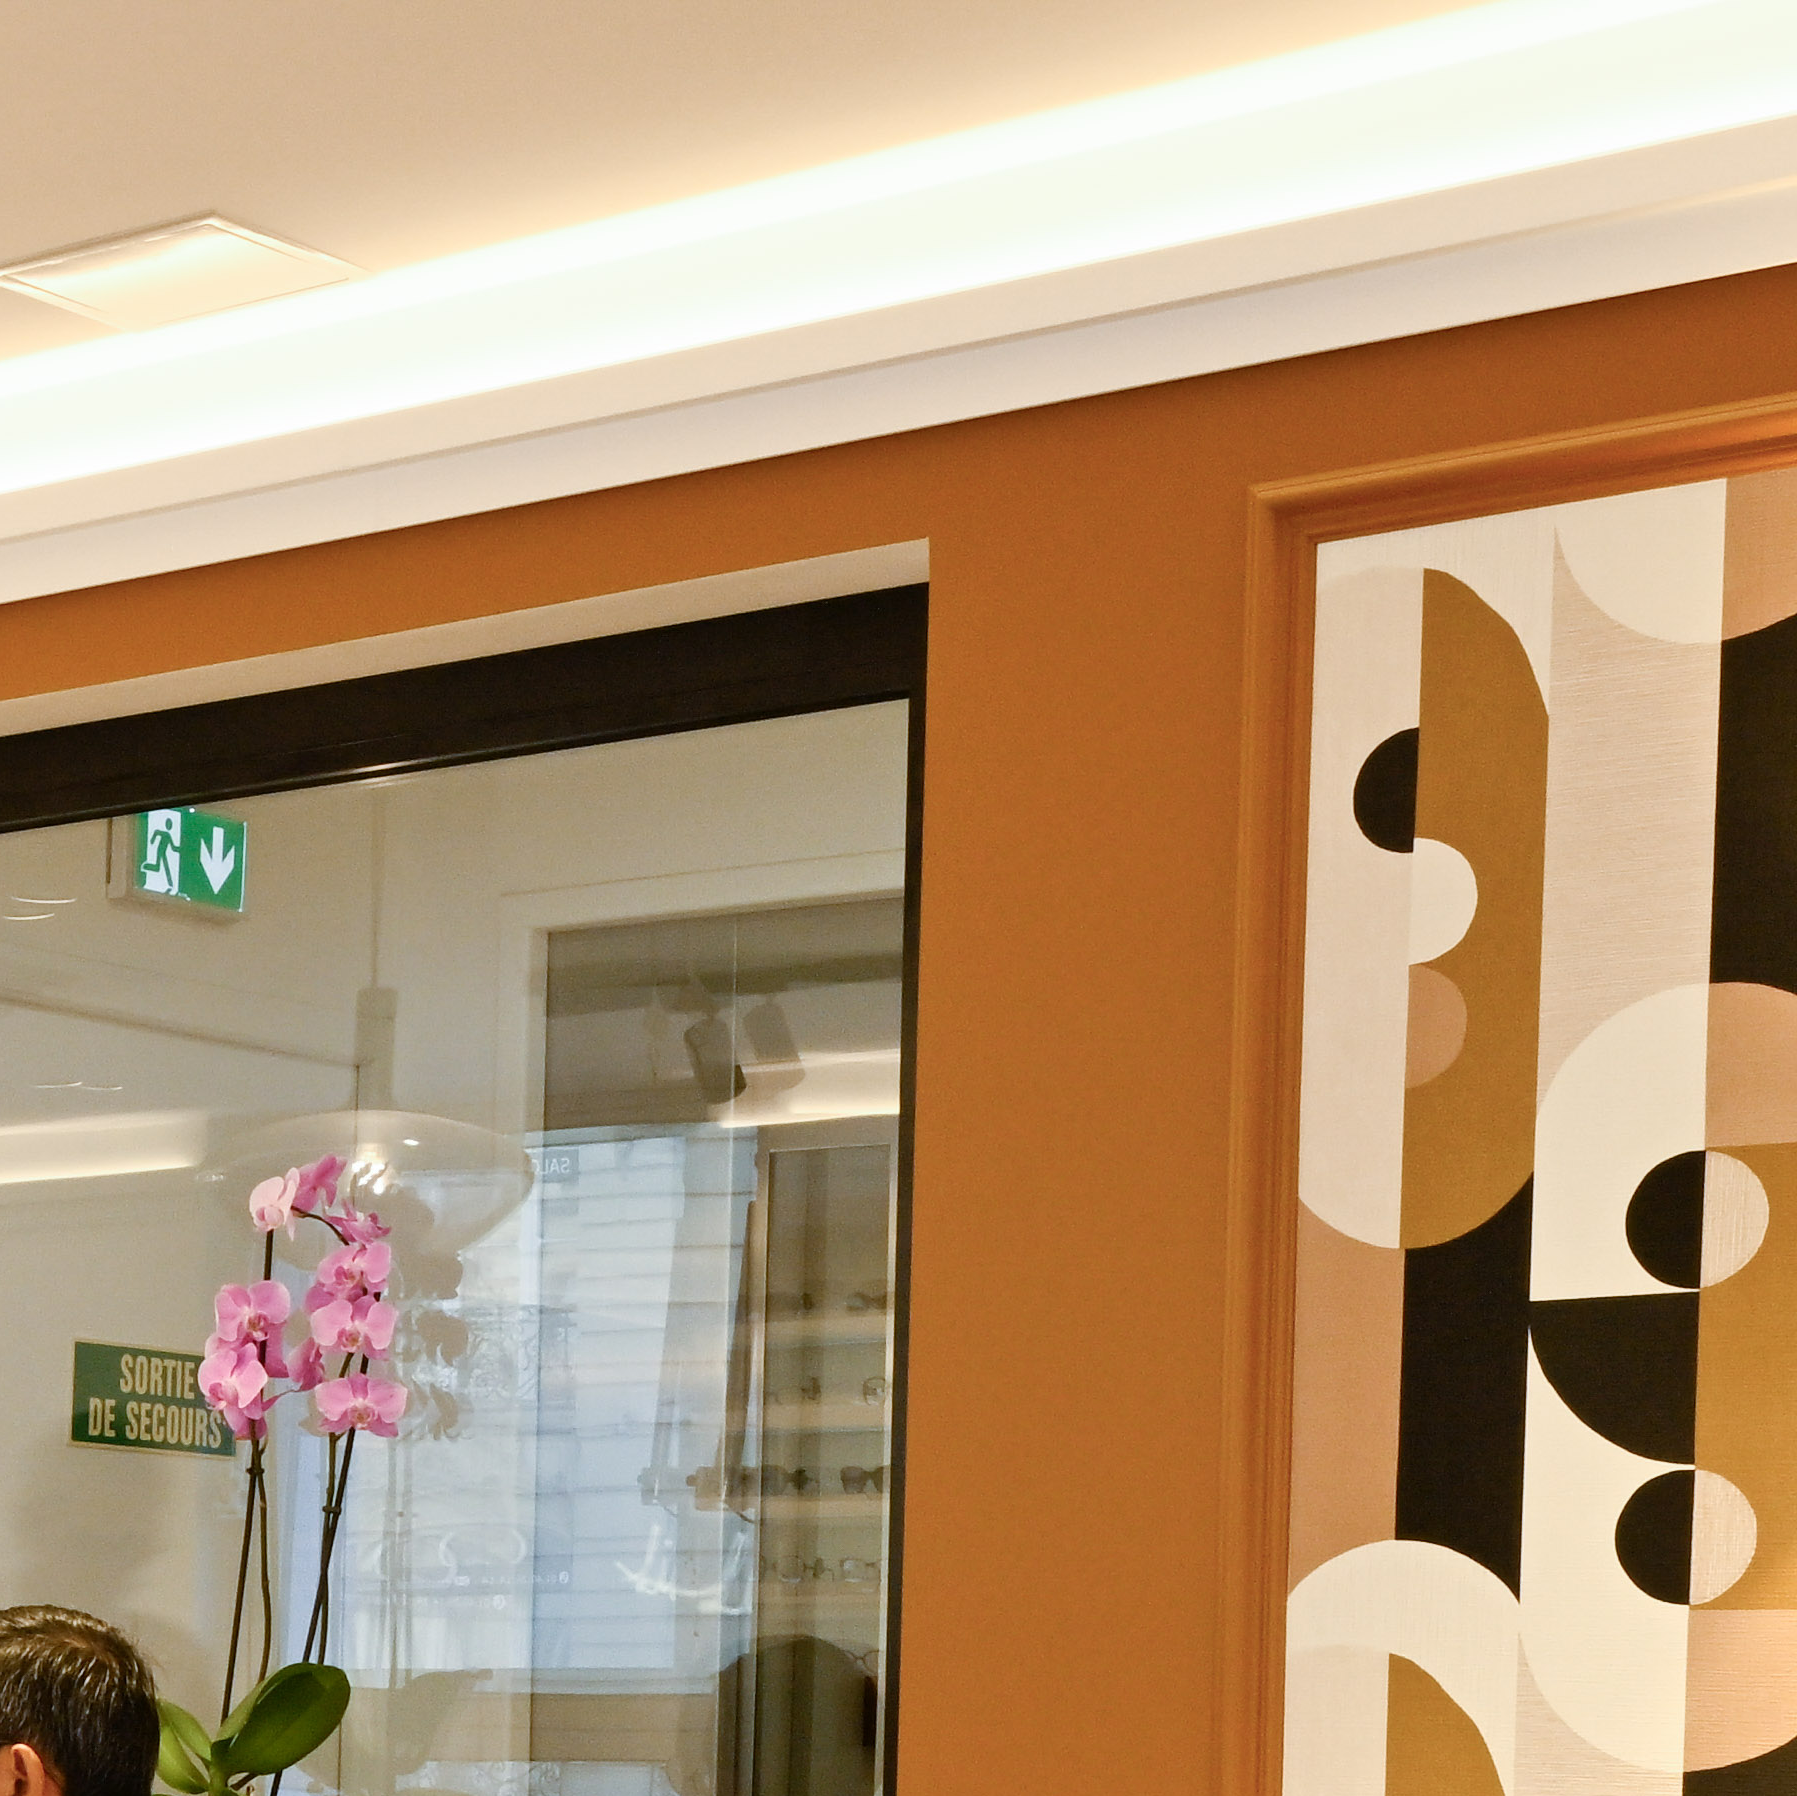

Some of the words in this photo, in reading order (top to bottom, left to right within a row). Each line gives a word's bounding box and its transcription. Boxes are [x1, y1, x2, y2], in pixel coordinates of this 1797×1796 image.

[119, 1353, 195, 1399] SORTIE
[88, 1397, 116, 1437] DE
[125, 1401, 222, 1448] SECOURS
